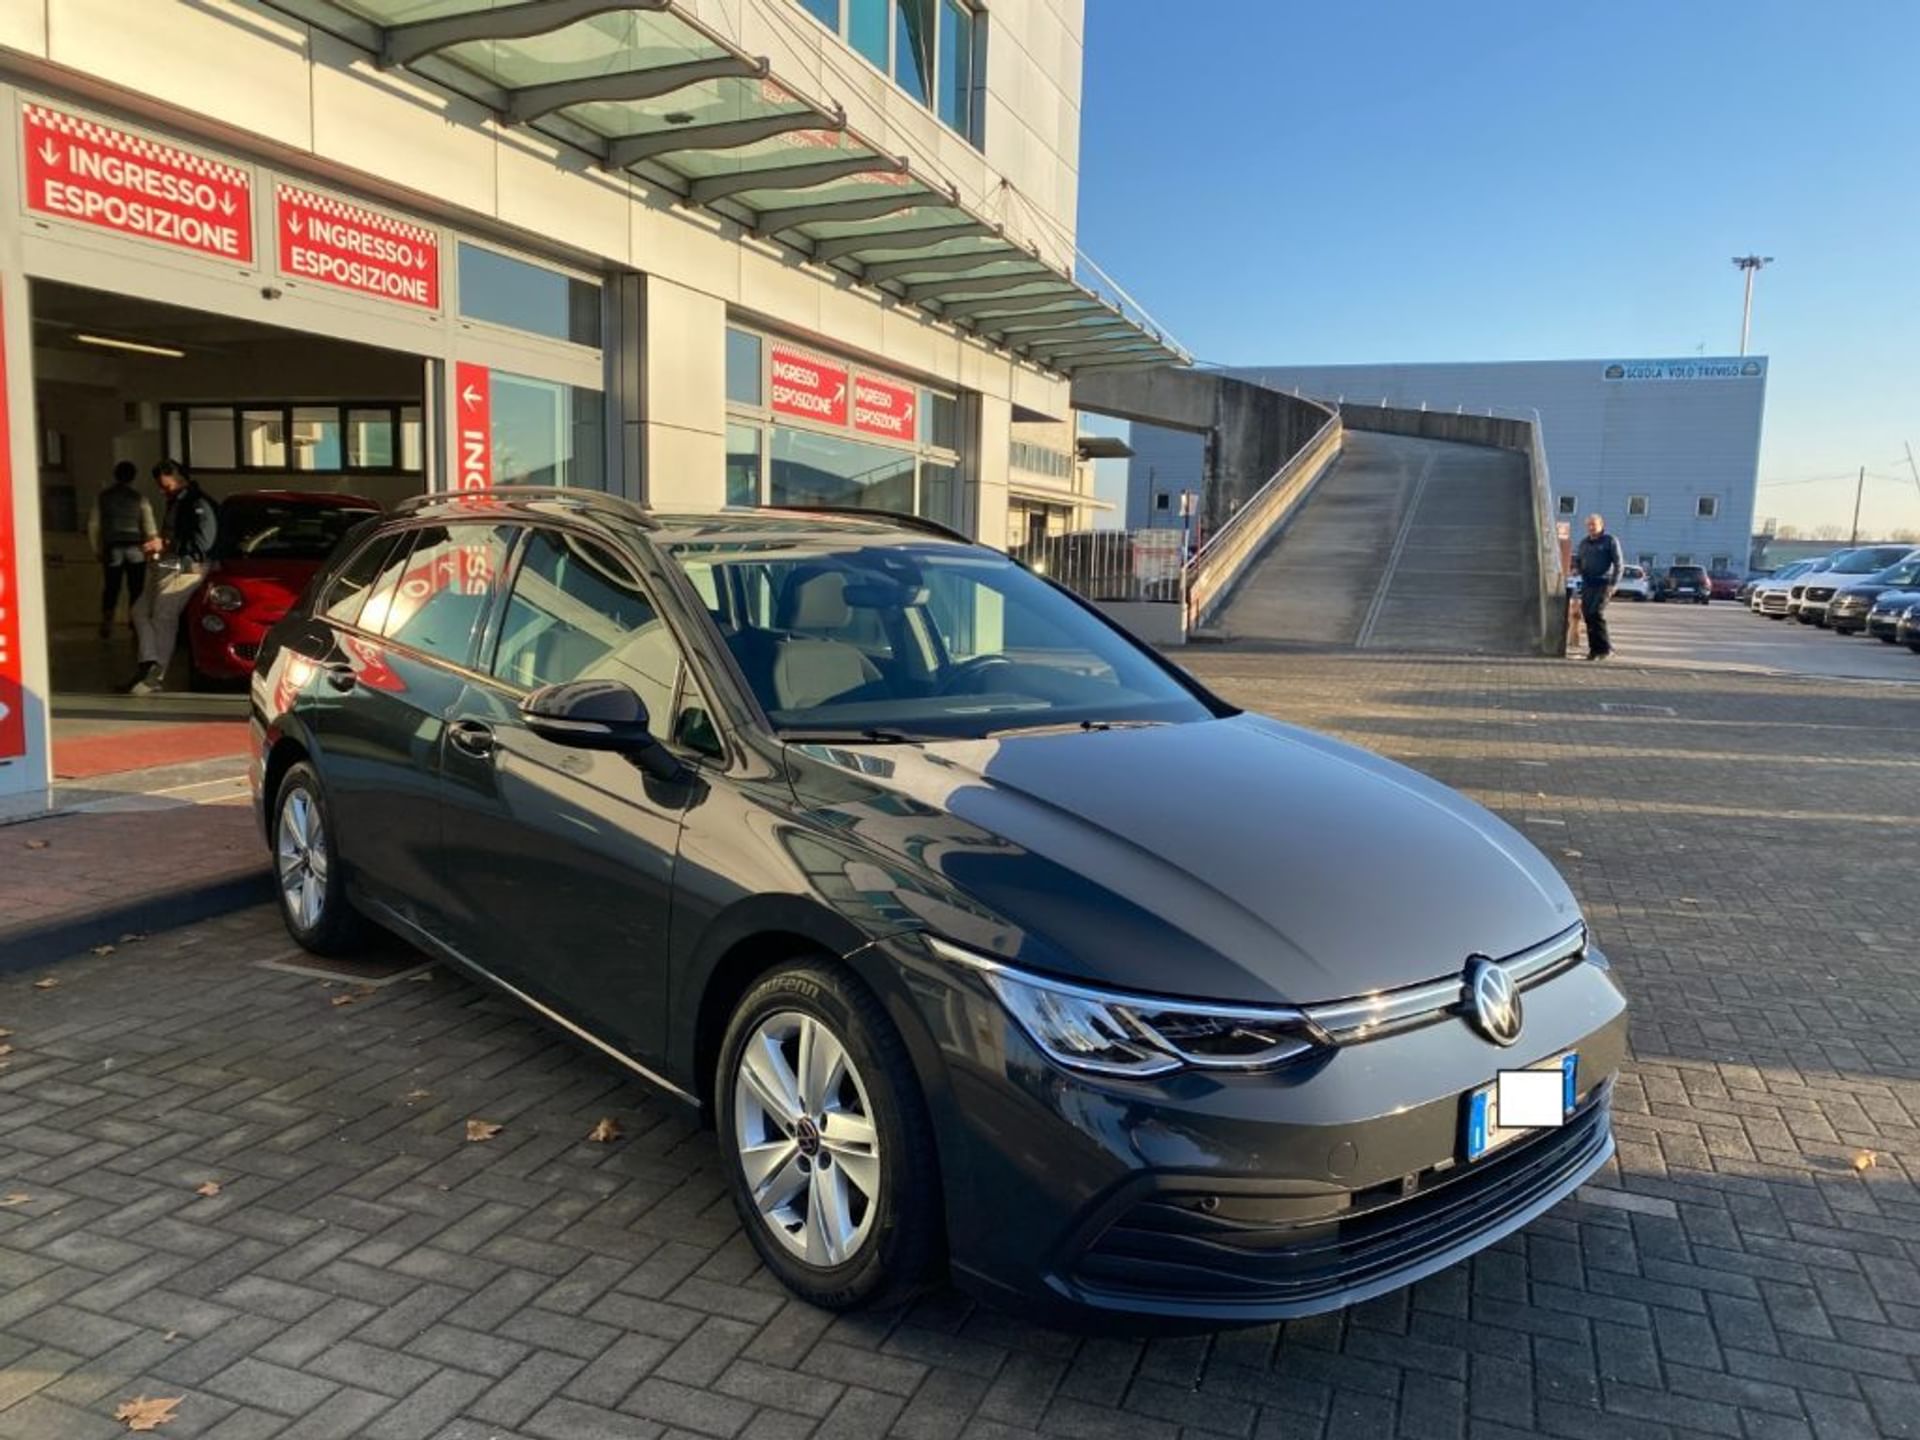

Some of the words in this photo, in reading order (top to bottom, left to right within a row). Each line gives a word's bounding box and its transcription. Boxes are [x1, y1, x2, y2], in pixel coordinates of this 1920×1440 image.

[69, 145, 217, 211] INGRESSO
[44, 180, 239, 255] ESPOSIZIONE
[308, 219, 413, 266] INGRESSO
[291, 247, 428, 302] ESPOSIZIONE
[772, 361, 819, 387] INGRESSO
[1626, 368, 1663, 379] SCUOLA
[1668, 367, 1694, 378] VOLO
[772, 385, 833, 416] ESPOSIZIONE
[855, 385, 892, 409] INGRESSO
[855, 407, 902, 432] ESPOSIZIONE
